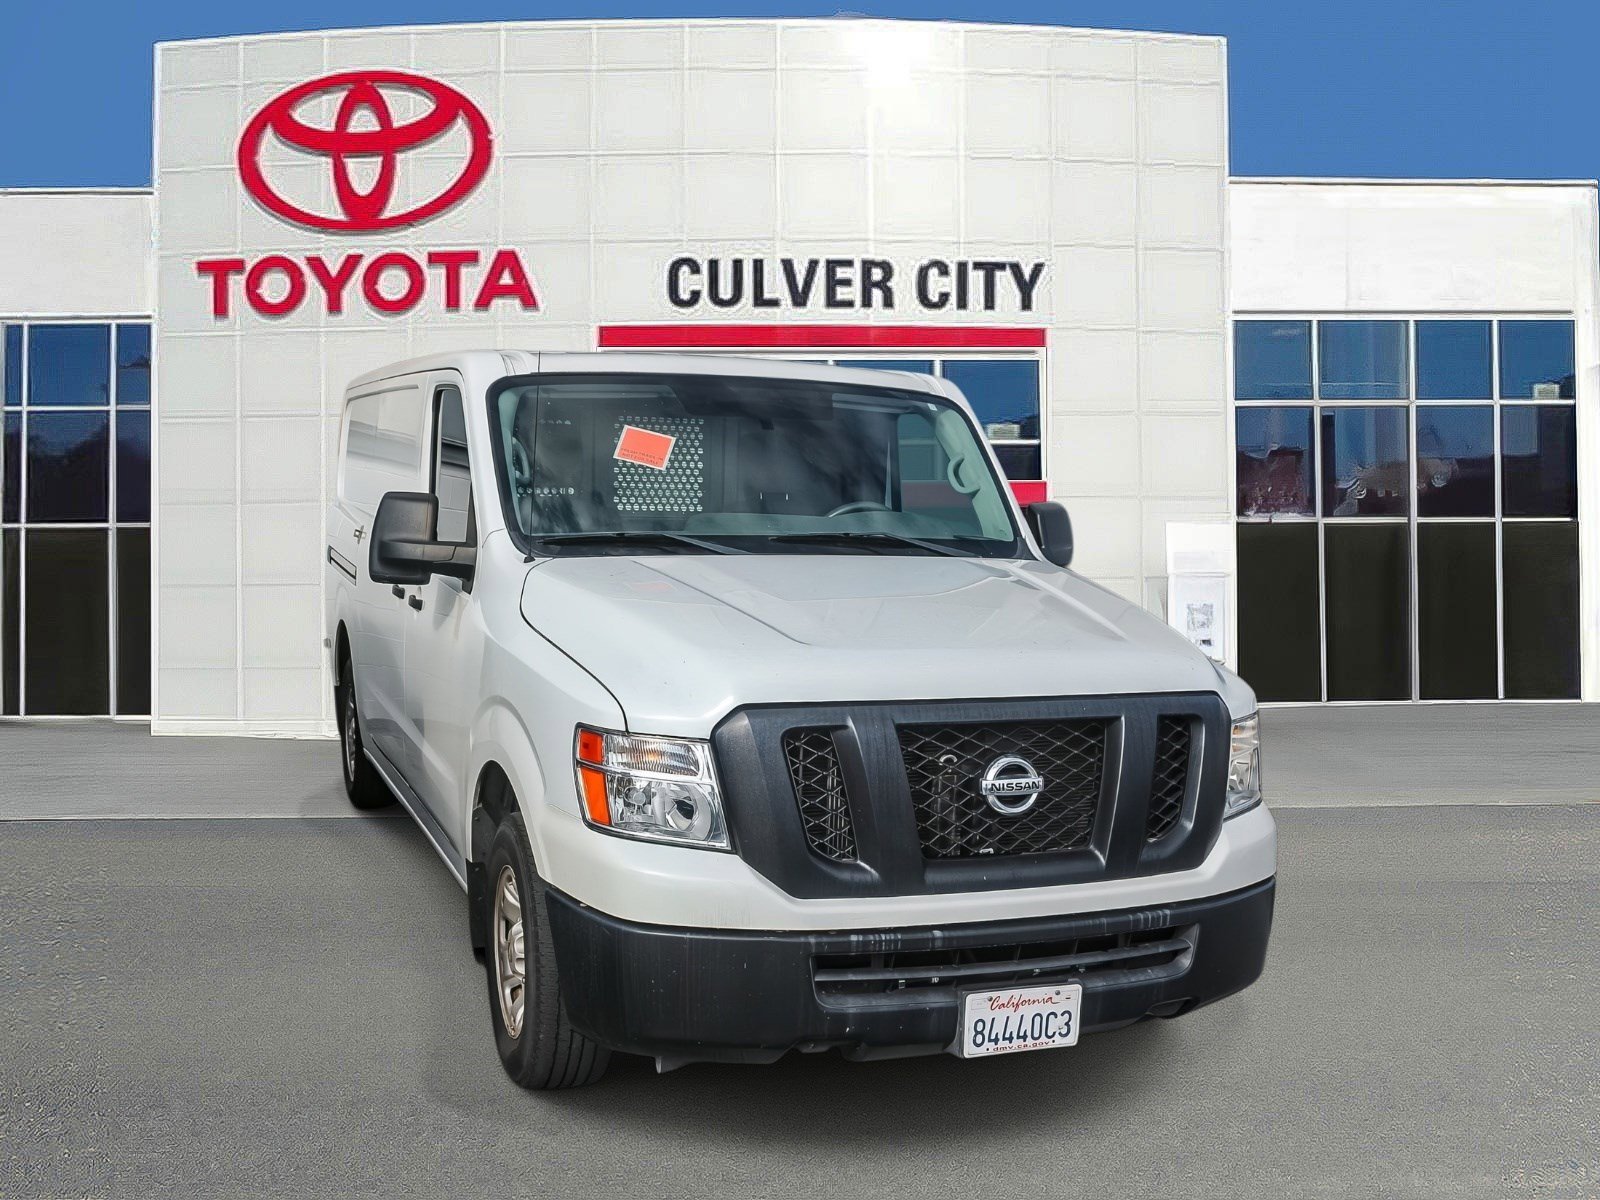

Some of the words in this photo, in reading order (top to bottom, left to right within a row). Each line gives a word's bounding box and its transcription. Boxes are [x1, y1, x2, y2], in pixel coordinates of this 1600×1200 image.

[197, 250, 538, 318] TOYOTA
[668, 257, 895, 309] CULVER
[916, 260, 1045, 310] CITY
[991, 781, 1040, 792] NISSAN
[989, 994, 1060, 1013] California
[972, 1010, 1072, 1048] 84440C3
[992, 1040, 1050, 1052] dmv.ca.gov
